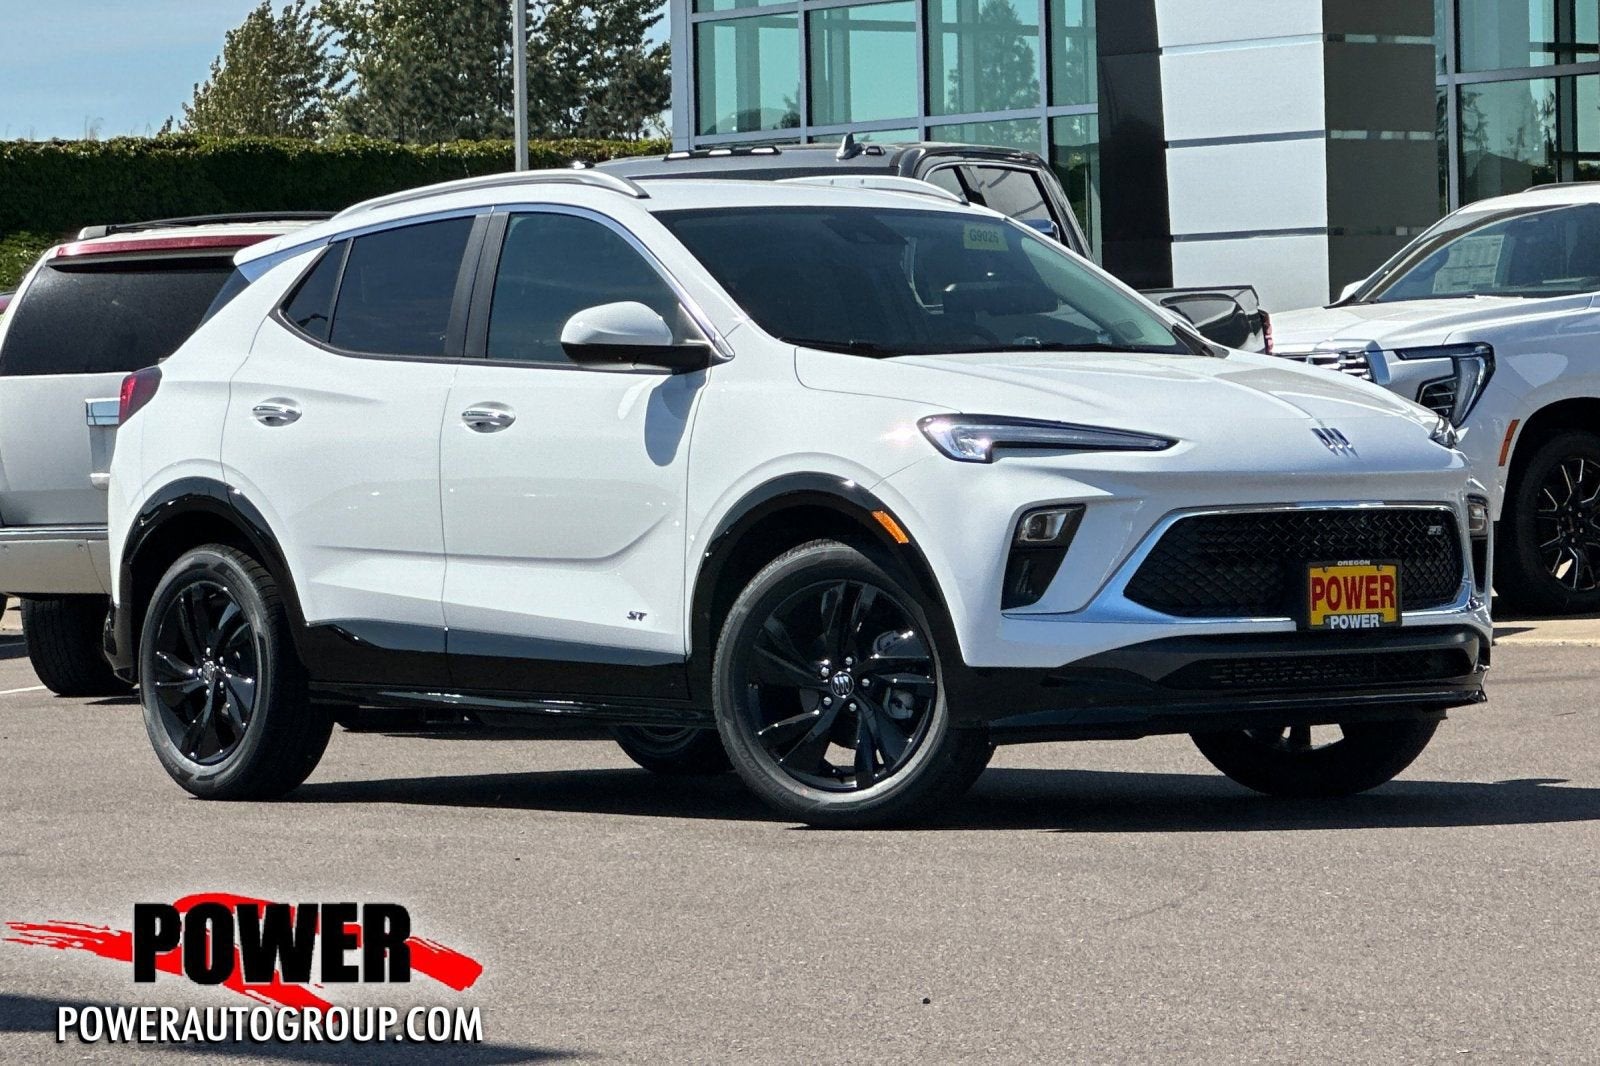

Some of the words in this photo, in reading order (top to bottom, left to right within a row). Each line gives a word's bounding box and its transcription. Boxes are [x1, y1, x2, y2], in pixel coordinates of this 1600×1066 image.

[1311, 575, 1395, 611] POWER
[626, 610, 648, 621] ST
[1330, 615, 1380, 629] POWER
